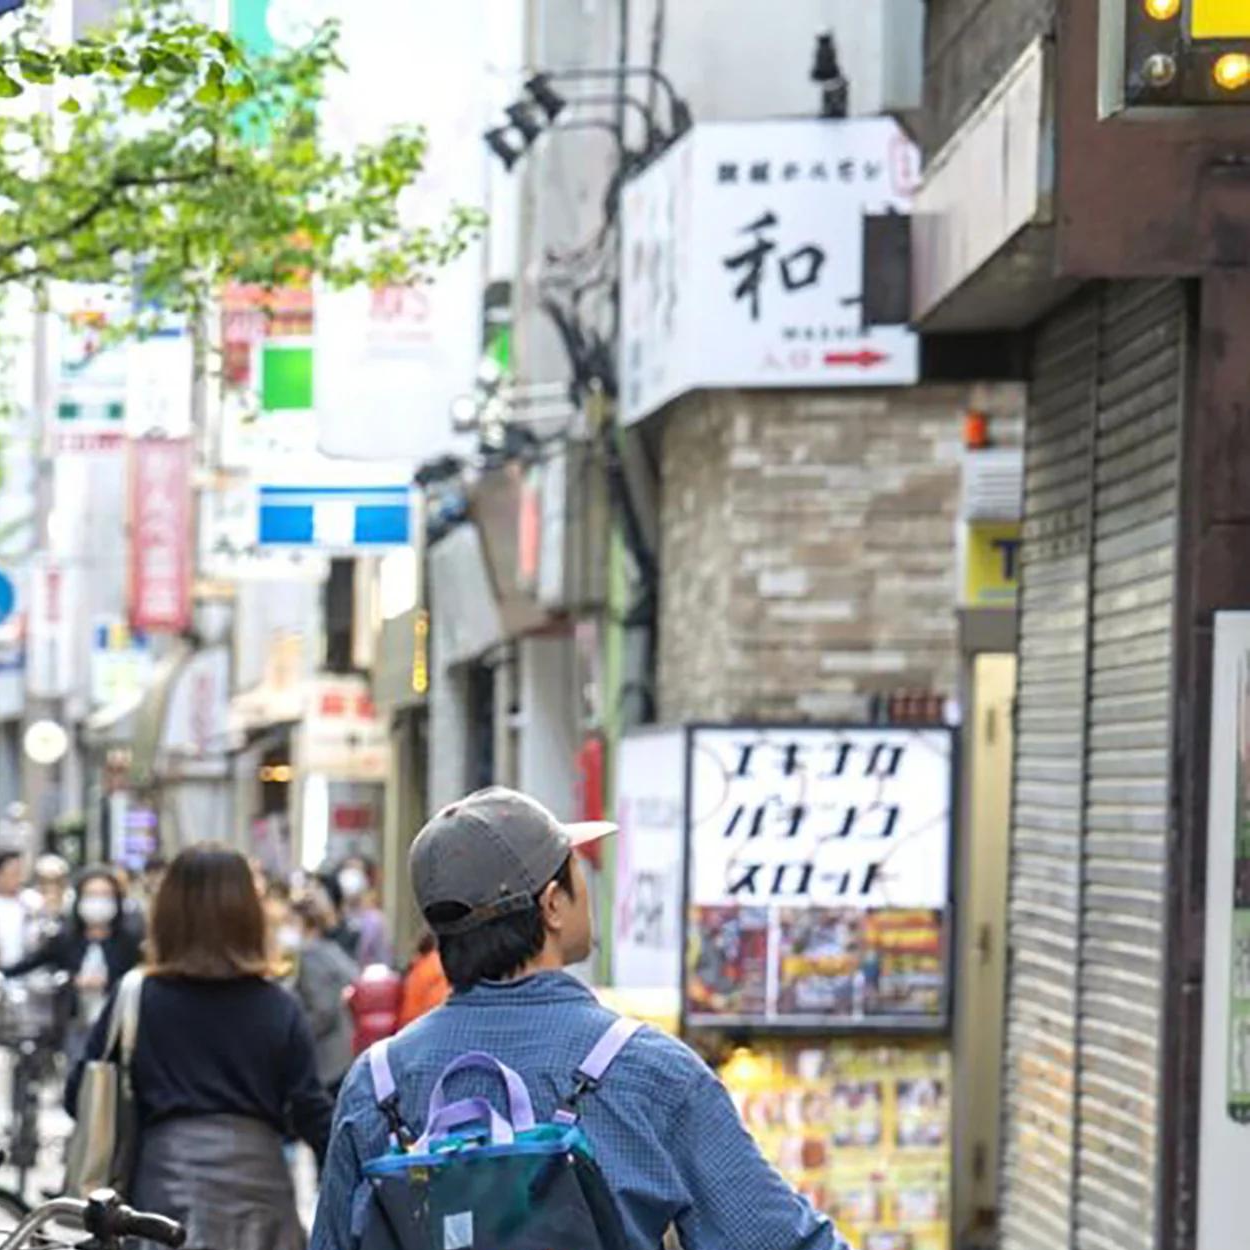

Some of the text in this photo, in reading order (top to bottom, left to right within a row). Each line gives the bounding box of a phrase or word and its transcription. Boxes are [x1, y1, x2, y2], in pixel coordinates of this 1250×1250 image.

[724, 793, 900, 839] パチンコ
[727, 862, 900, 896] スロット
